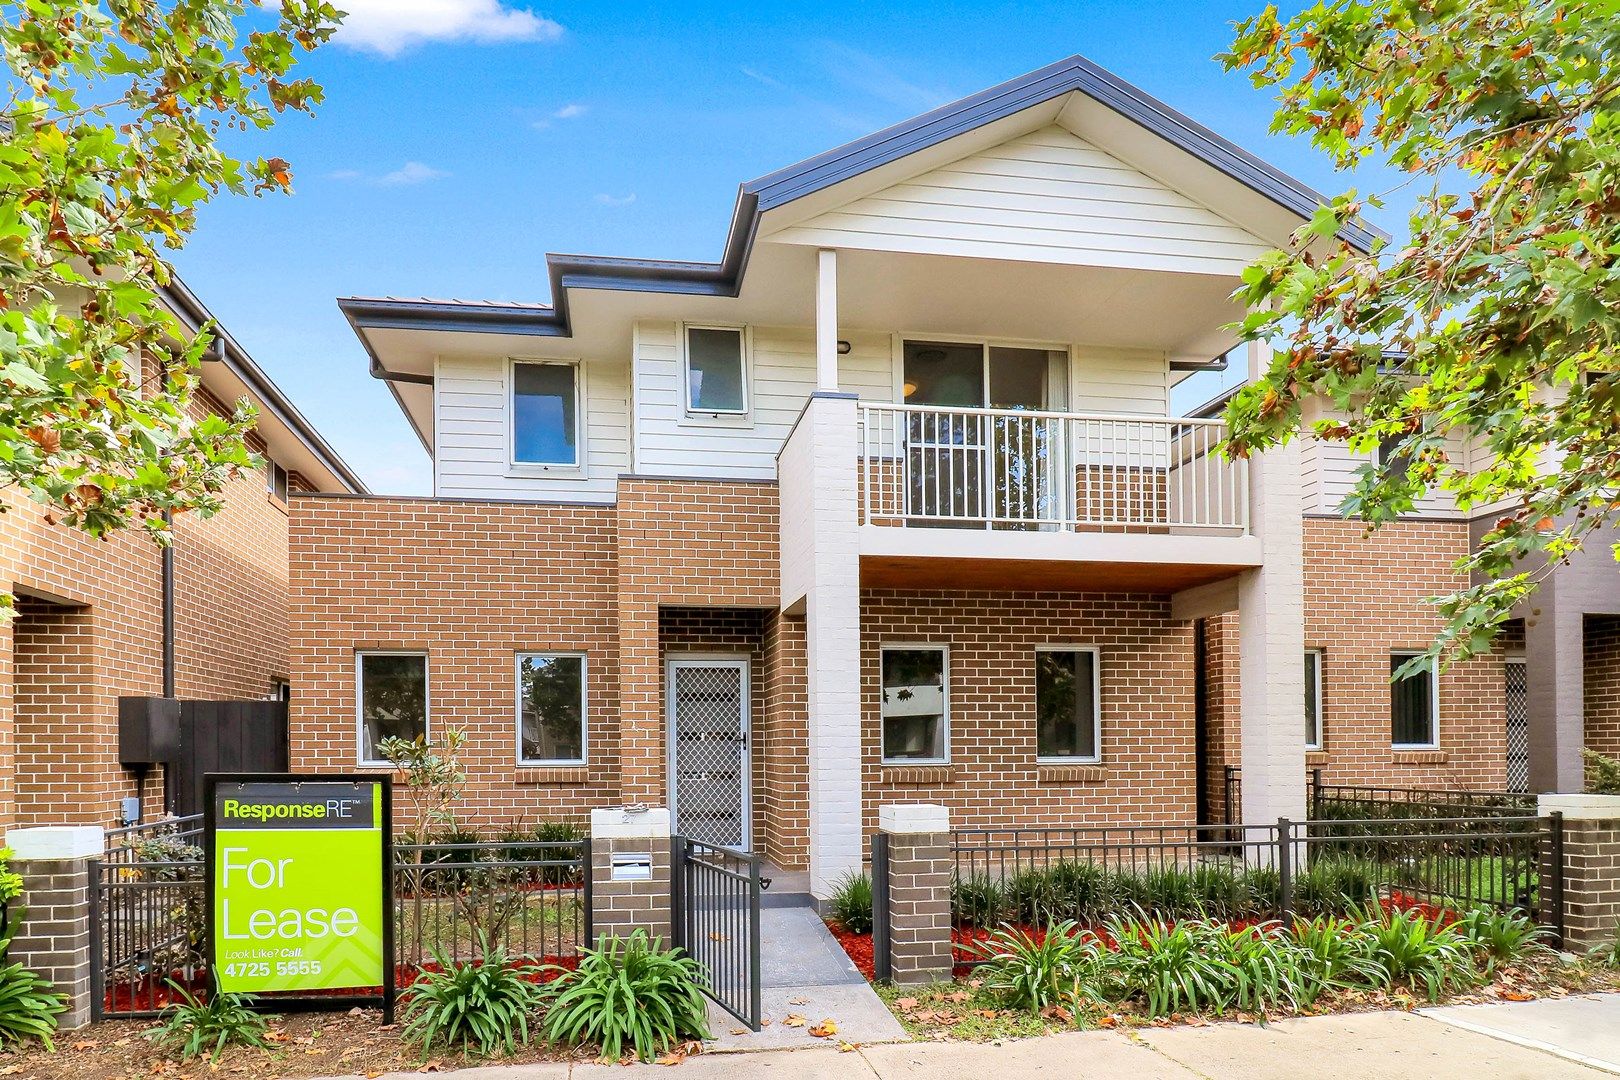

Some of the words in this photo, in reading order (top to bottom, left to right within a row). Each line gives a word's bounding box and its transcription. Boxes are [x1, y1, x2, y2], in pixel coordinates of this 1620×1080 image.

[223, 847, 294, 889] For
[223, 898, 359, 940] Lease
[252, 948, 279, 959] Like?
[224, 962, 271, 978] 4725
[276, 960, 322, 976] 5555
